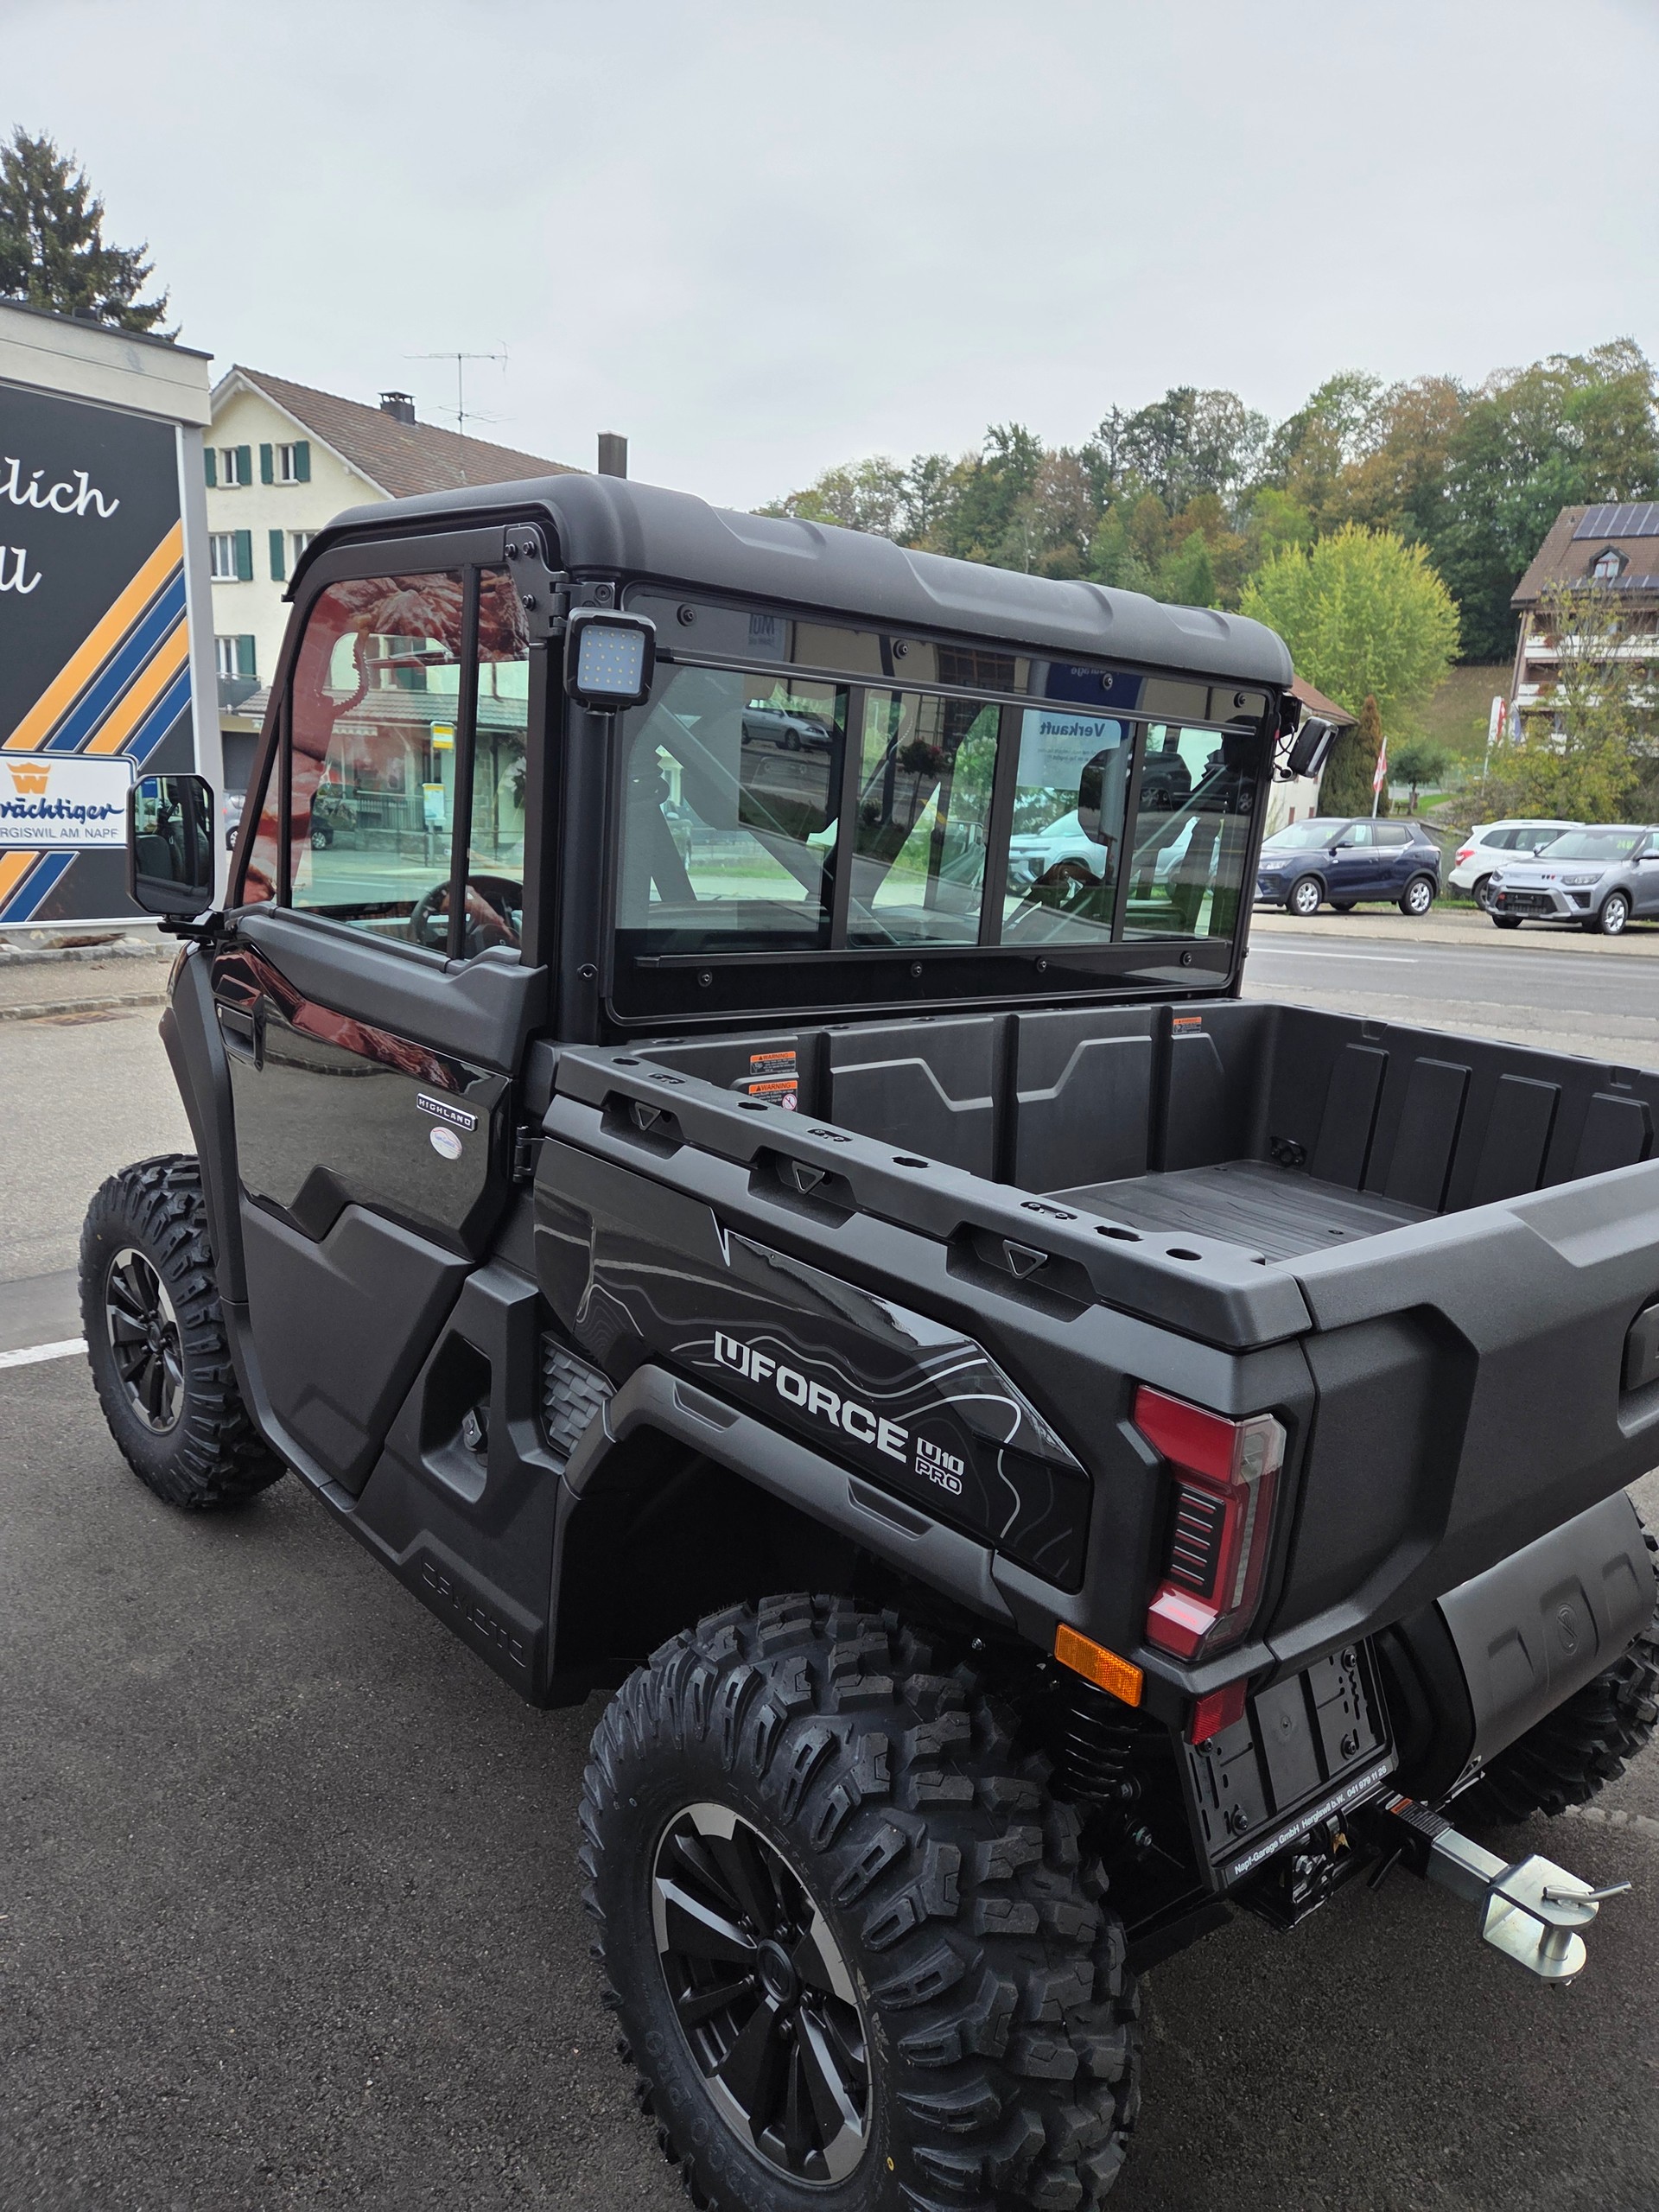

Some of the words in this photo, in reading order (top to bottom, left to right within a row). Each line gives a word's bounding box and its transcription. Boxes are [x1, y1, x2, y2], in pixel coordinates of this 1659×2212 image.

[0, 457, 120, 518] lich
[60, 828, 79, 838] AM
[85, 828, 118, 839] NAPF
[419, 1098, 471, 1126] HIGHLAND
[714, 1331, 909, 1464] UFORCE
[916, 1437, 964, 1476] U10
[915, 1457, 963, 1496] PRO
[1234, 1840, 1278, 1875] Napf-Garage
[1279, 1824, 1300, 1845] GmbH
[1347, 1785, 1358, 1797] 041
[1359, 1776, 1371, 1789] 979
